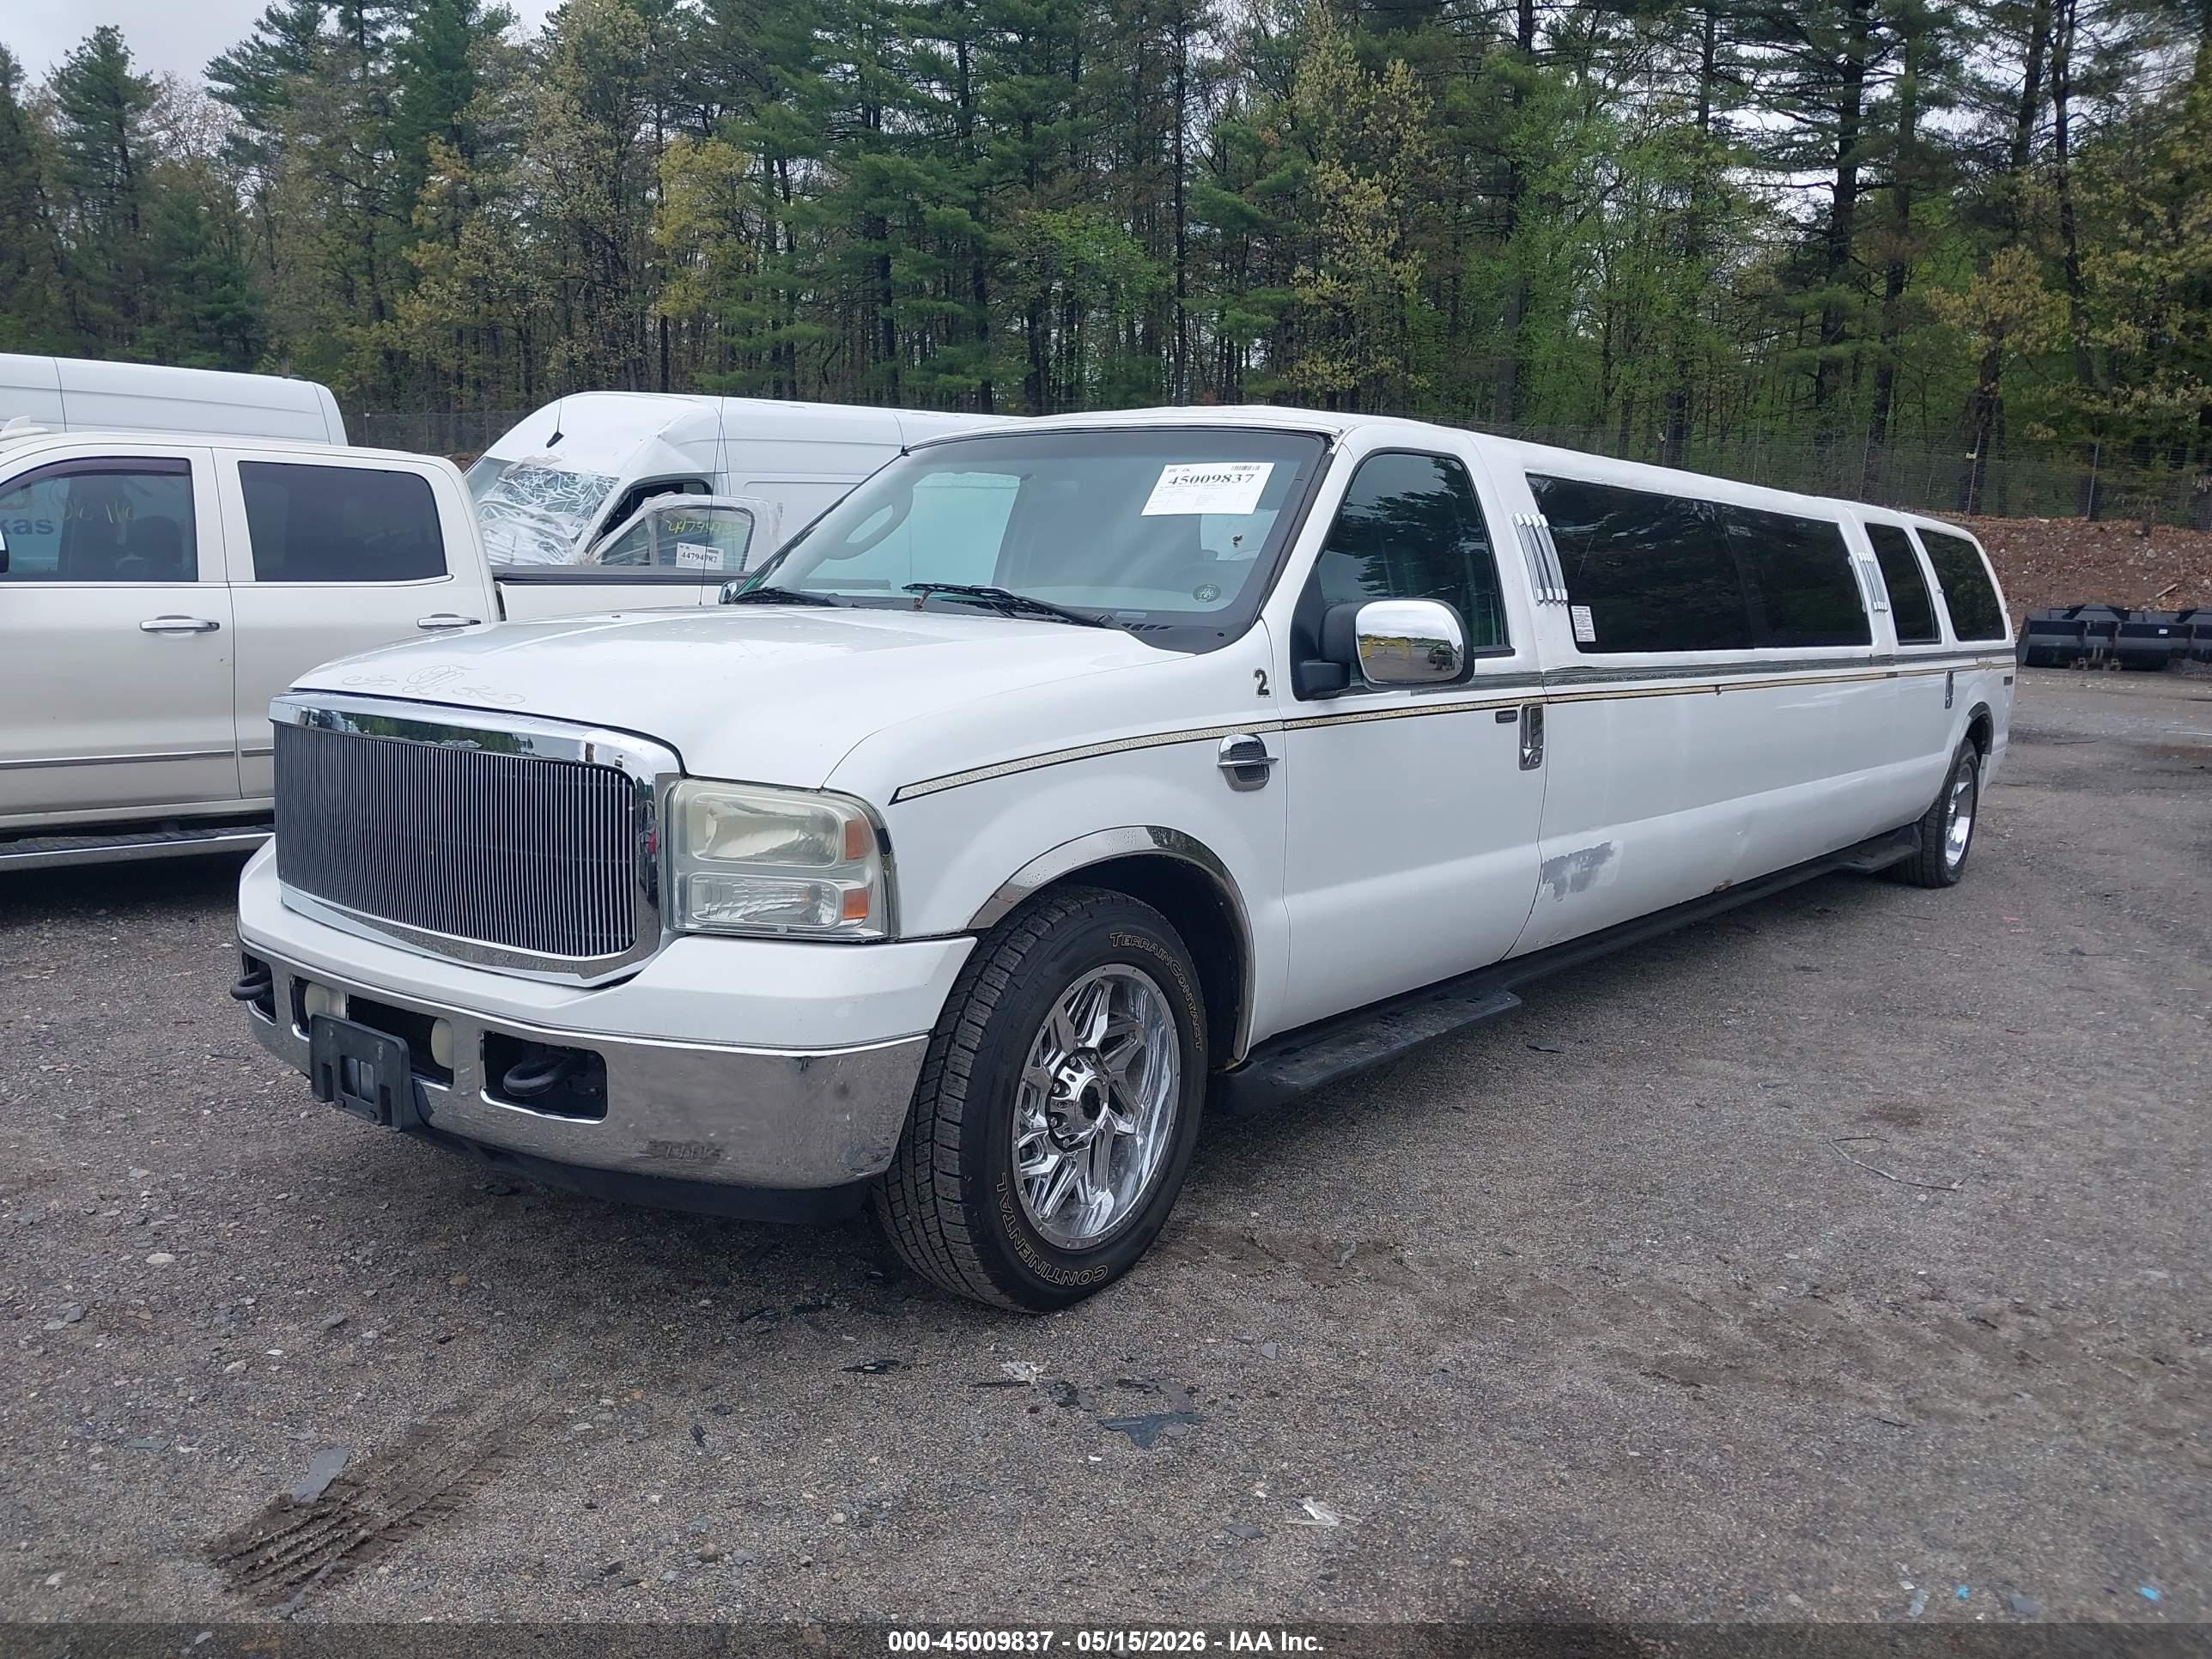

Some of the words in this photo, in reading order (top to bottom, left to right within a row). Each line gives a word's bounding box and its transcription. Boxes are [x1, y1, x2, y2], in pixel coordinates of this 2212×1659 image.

[1168, 474, 1256, 485] 45009837
[1254, 668, 1270, 696] 2
[1109, 932, 1203, 1052] TERRAINCONTACT
[996, 1172, 1109, 1286] CONTINENTAL
